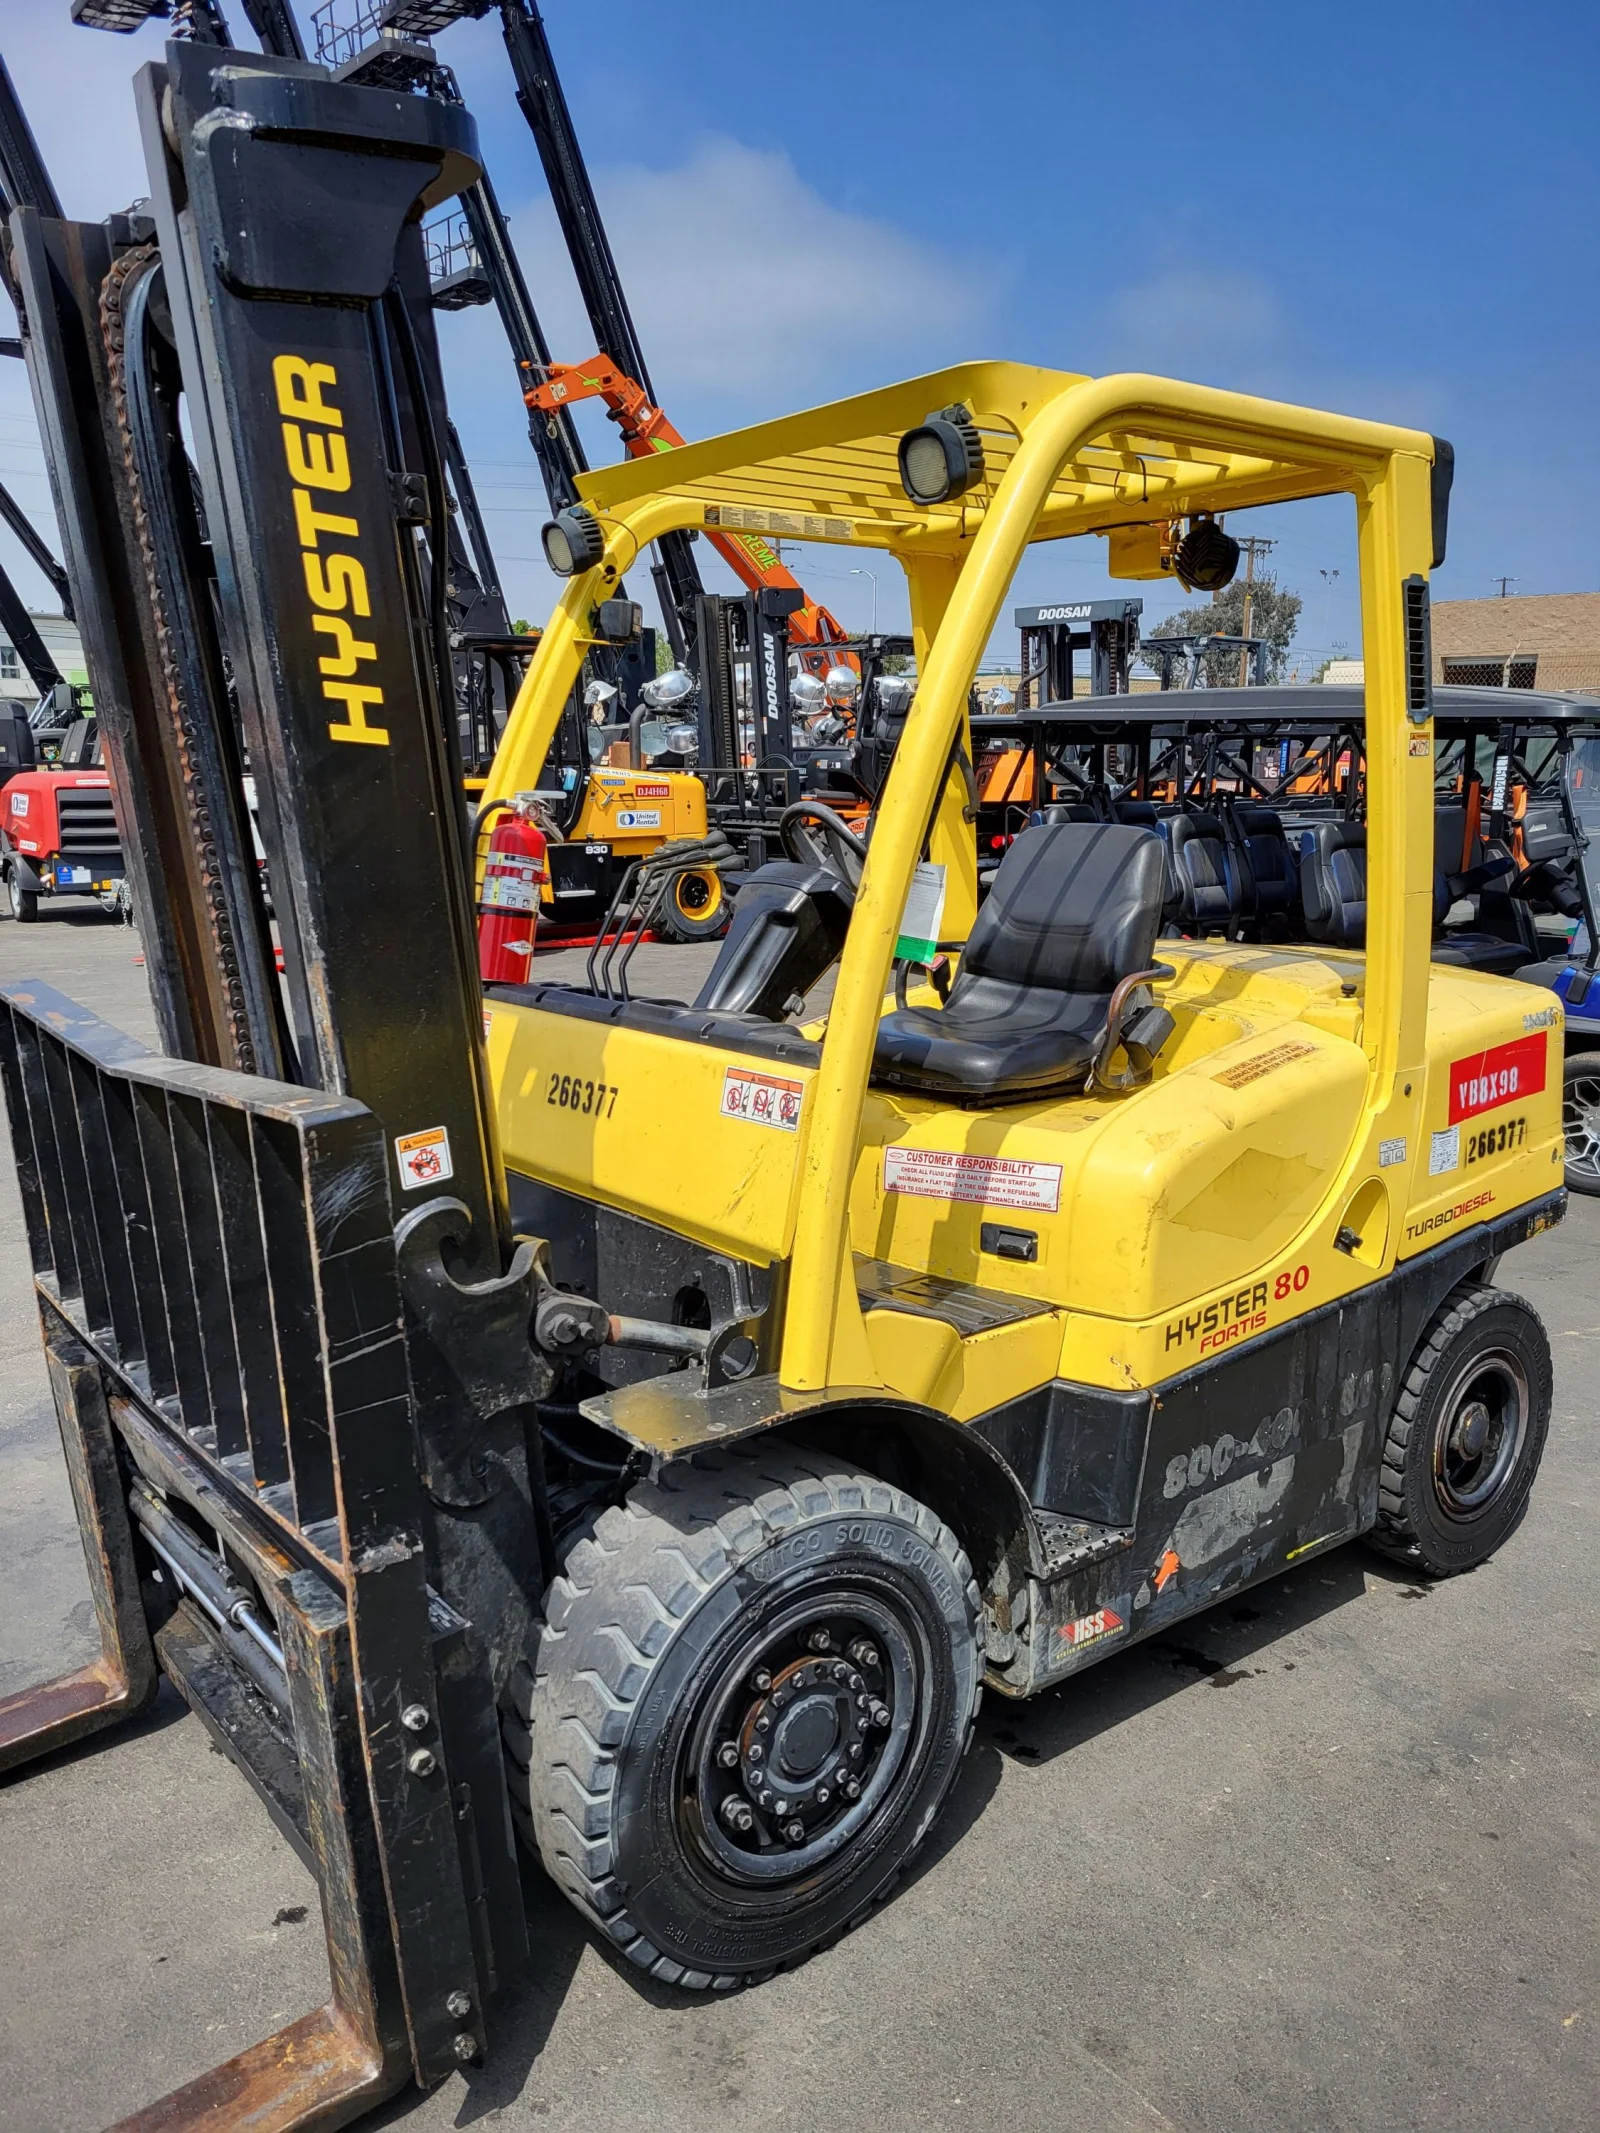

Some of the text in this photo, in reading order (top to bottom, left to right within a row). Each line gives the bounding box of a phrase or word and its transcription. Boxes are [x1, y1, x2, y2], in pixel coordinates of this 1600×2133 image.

[272, 354, 391, 746] HYSTER
[1038, 605, 1092, 620] DOOSAN
[763, 632, 779, 720] DOOSAN
[637, 787, 668, 796] DJ4H68
[585, 845, 608, 854] 930
[547, 1073, 619, 1119] 266377
[1459, 1066, 1518, 1110] VB8X98
[1467, 1117, 1526, 1164] 266377
[901, 1166, 917, 1174] CHECK
[945, 1171, 966, 1180] LEVELS
[967, 1174, 983, 1182] DAILY
[983, 1176, 1007, 1185] BEFORE
[1008, 1179, 1037, 1188] START-UP
[906, 1151, 1035, 1175] CUSTOMER RESPONSIBILITY
[915, 1186, 944, 1195] EQUIPMENT
[949, 1190, 973, 1199] BATTERY
[974, 1193, 1015, 1204] MAINTENANCE
[1021, 1200, 1052, 1209] CLEANING
[943, 1180, 958, 1188] TIRES
[964, 1182, 976, 1190] TIRE
[977, 1184, 1001, 1193] DAMAGE
[1007, 1188, 1040, 1198] REFUELING
[1406, 1189, 1496, 1240] TURBODIESEL
[1165, 1264, 1310, 1352] HYSTER 80
[1200, 1310, 1267, 1354] FORTIS
[752, 1524, 953, 1606] MITCO SOLID SOLVER
[1074, 1610, 1105, 1645] HSS
[633, 1689, 667, 1768] MADE IN USA
